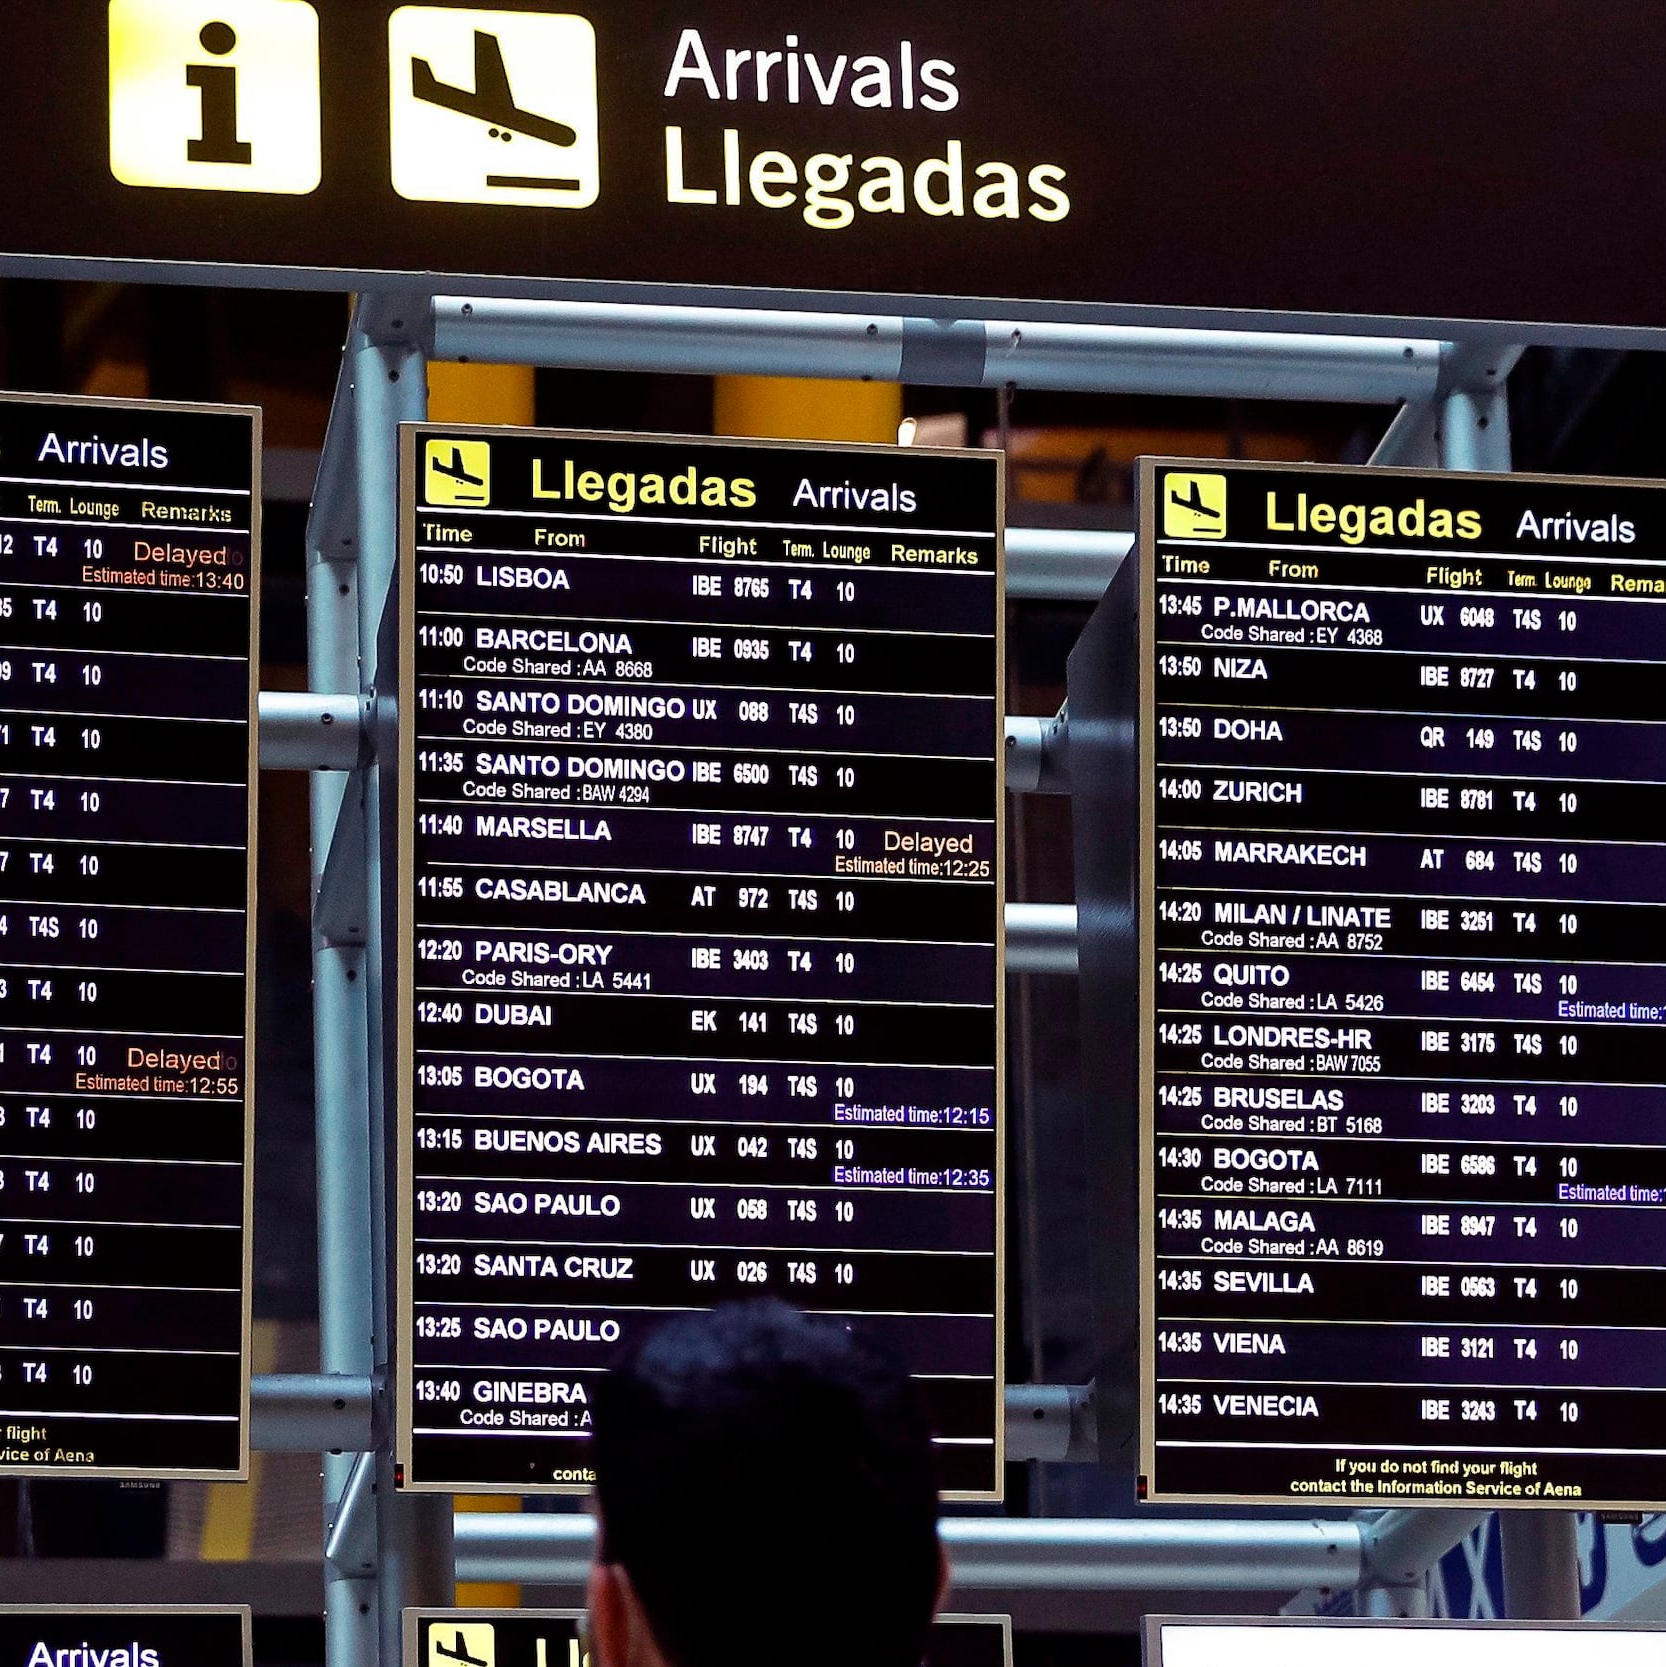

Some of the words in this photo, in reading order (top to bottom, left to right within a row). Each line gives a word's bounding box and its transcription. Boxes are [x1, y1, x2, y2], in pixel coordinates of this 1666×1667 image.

[664, 29, 958, 111] Arrivals
[666, 126, 1070, 229] Llegadas
[38, 433, 168, 468] Arrivals
[533, 459, 756, 513] Llegadas
[793, 479, 916, 512] Arrivals
[28, 495, 61, 513] Term.
[71, 497, 119, 520] Lounge
[142, 501, 231, 522] Remarks
[1267, 492, 1481, 544] Llegadas
[1516, 510, 1635, 543] Arrivals
[33, 536, 57, 556] T4
[84, 539, 102, 558] 10
[135, 542, 226, 568] Delayed
[420, 563, 463, 584] 10:50
[477, 566, 570, 589] LISBOA
[693, 575, 721, 596] IBE
[734, 577, 769, 598] 8765
[788, 579, 812, 600] T4
[837, 582, 854, 601] 10
[33, 599, 57, 620] T4
[84, 602, 101, 622] 10
[419, 626, 463, 647] 11:00
[477, 628, 632, 654] BARCELONA
[693, 637, 721, 658] IBE
[734, 639, 769, 660] 0935
[788, 641, 812, 662] T4
[837, 643, 854, 663] 10
[1159, 655, 1201, 676] 13:50
[1214, 657, 1267, 679] NIZA
[1421, 666, 1448, 686] IBE
[1461, 667, 1494, 688] 8727
[1513, 669, 1535, 689] T4
[1559, 672, 1576, 691] 10
[1159, 1394, 1201, 1414] 14:35
[1213, 1395, 1318, 1416] VENECIA
[1422, 1399, 1449, 1420] IBE
[1461, 1400, 1495, 1420] 3243
[1514, 1400, 1537, 1420] T4
[1560, 1402, 1578, 1422] 10
